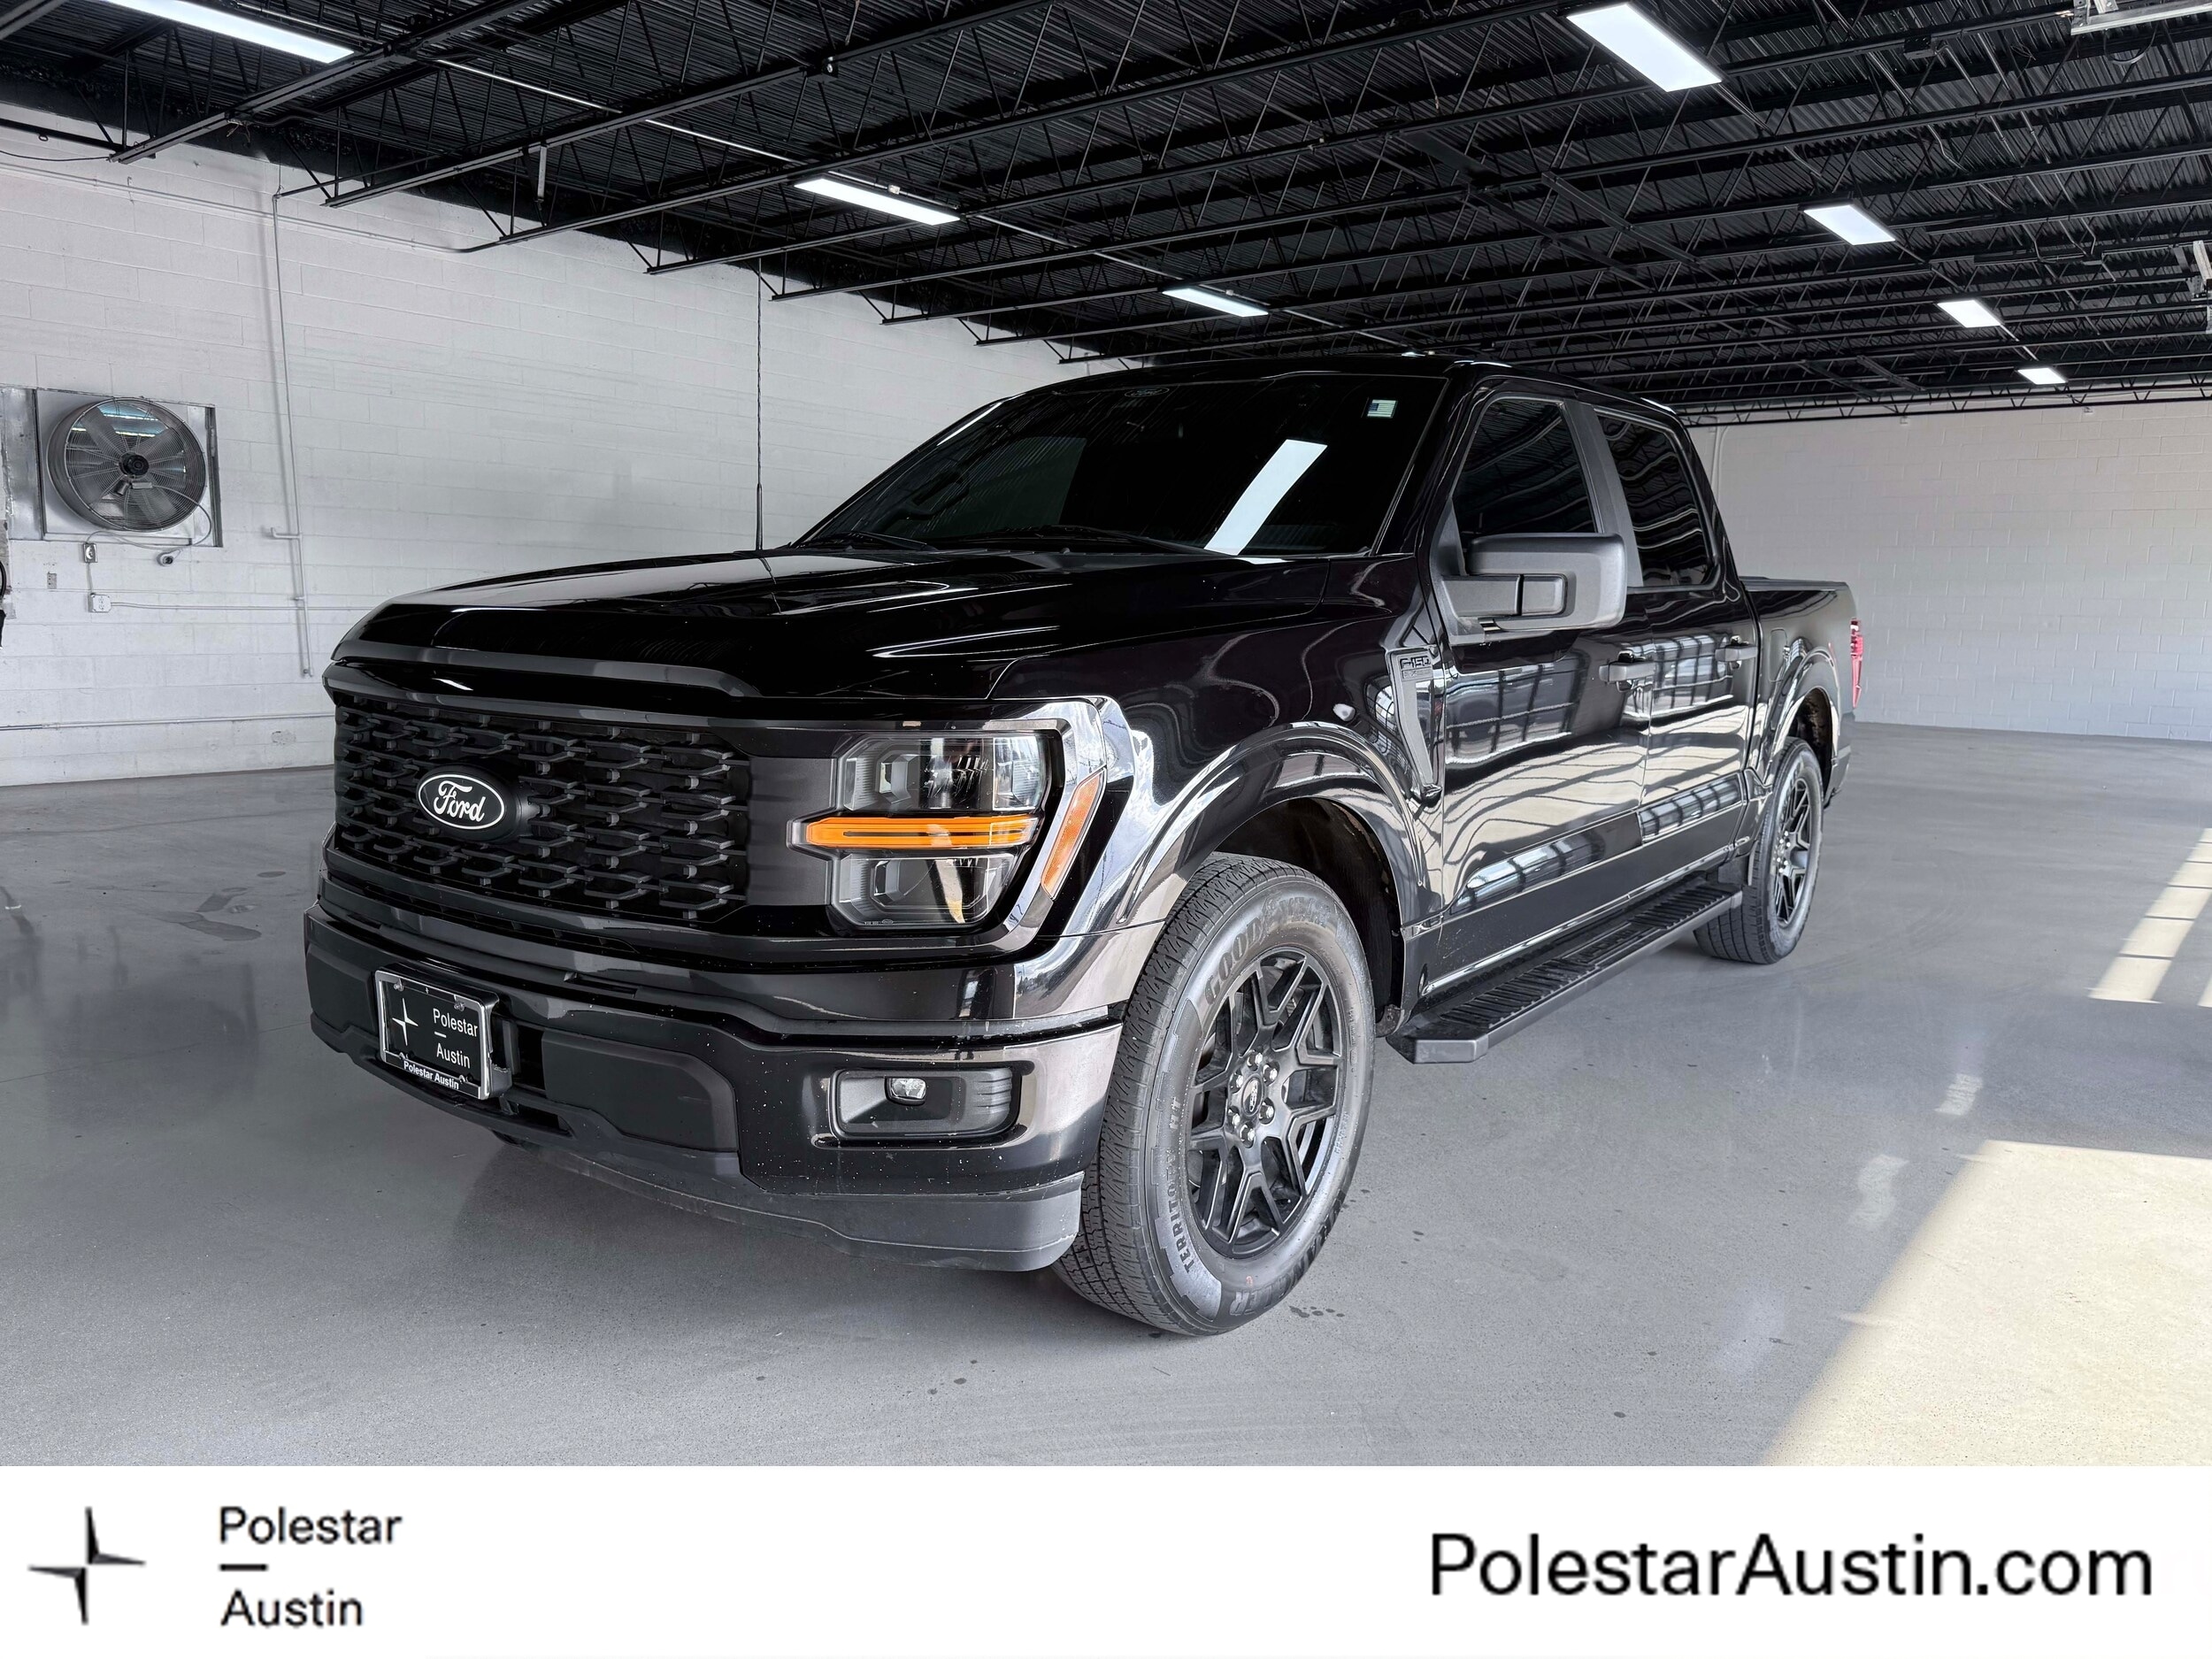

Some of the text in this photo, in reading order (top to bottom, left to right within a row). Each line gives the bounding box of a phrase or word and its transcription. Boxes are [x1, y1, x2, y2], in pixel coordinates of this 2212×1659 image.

[433, 780, 487, 822] Ford
[433, 1007, 479, 1038] Polestar
[435, 1042, 472, 1070] Austin
[403, 1060, 460, 1091] Polestar Austin
